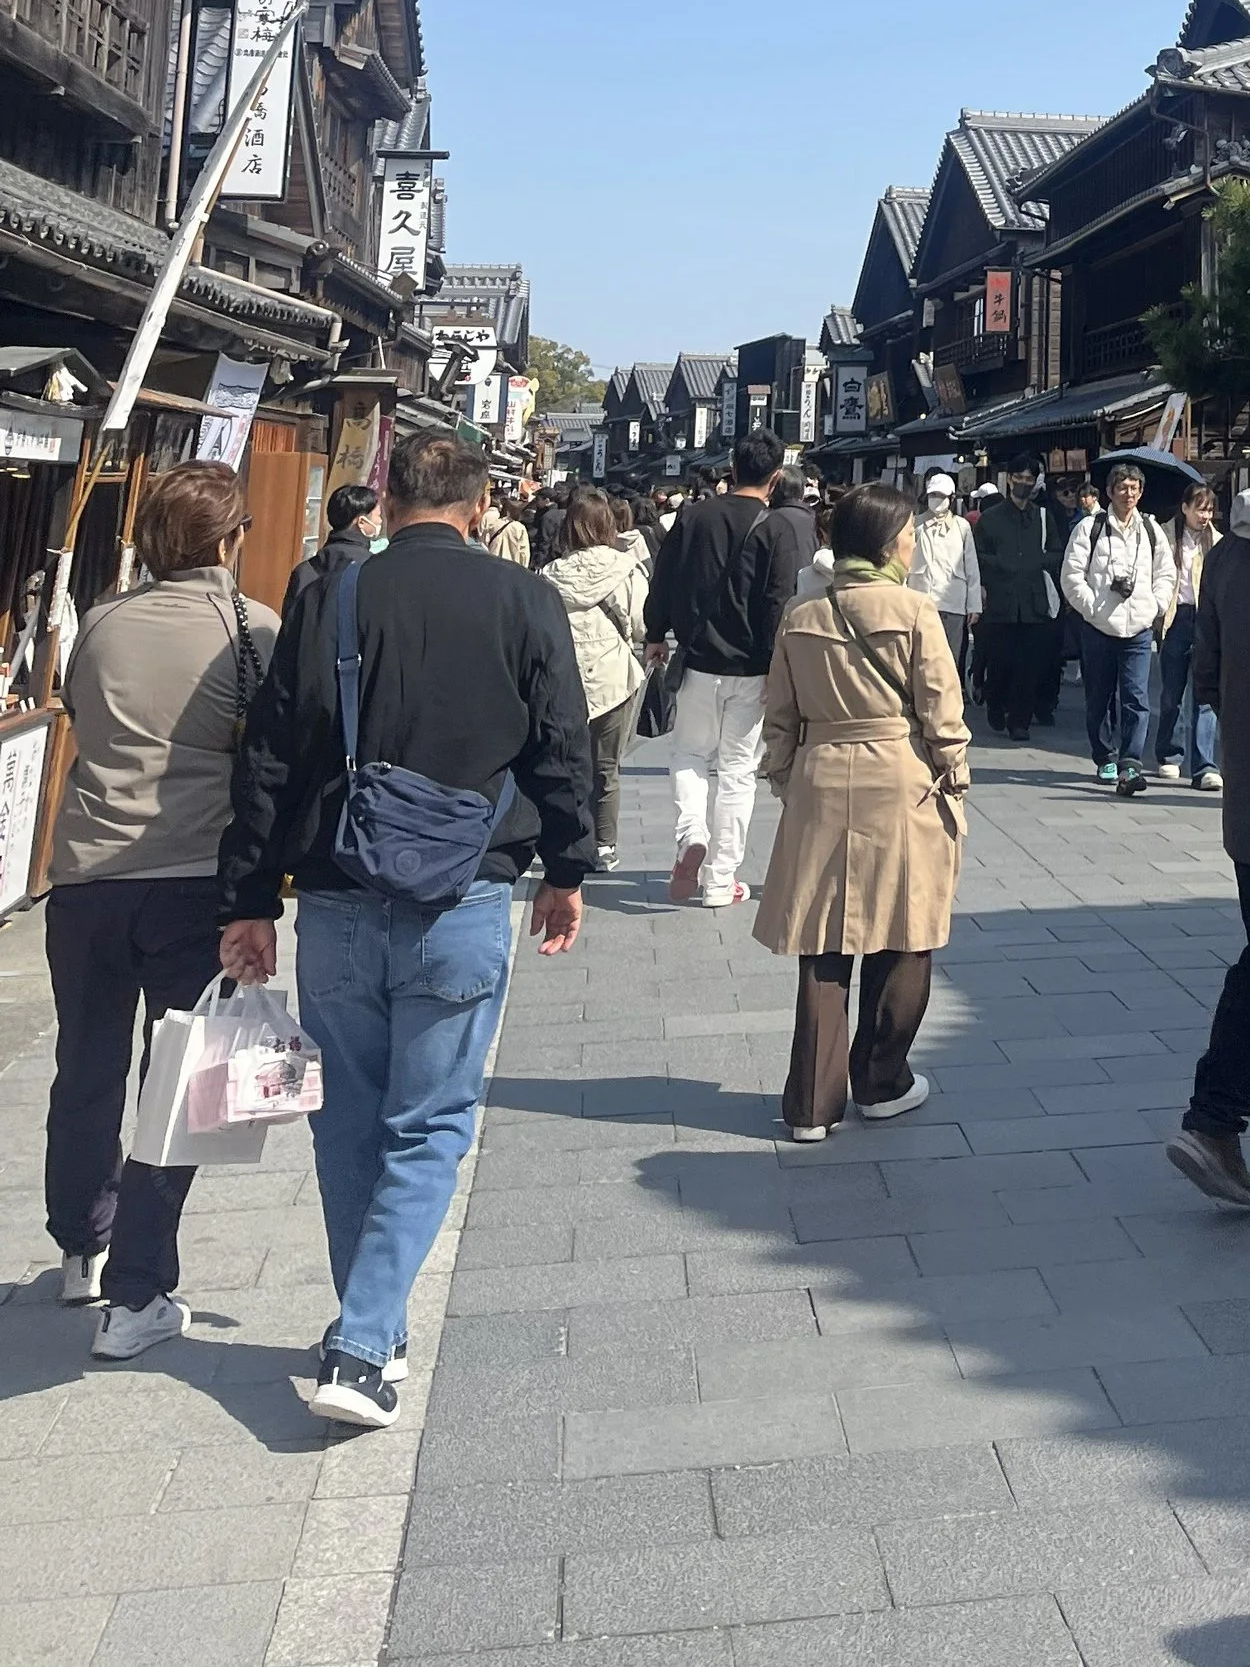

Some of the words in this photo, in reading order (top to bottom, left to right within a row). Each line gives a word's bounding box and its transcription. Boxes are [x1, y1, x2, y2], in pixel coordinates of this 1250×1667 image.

[386, 170, 424, 276] 喜久屋
[840, 377, 864, 421] 白鷹
